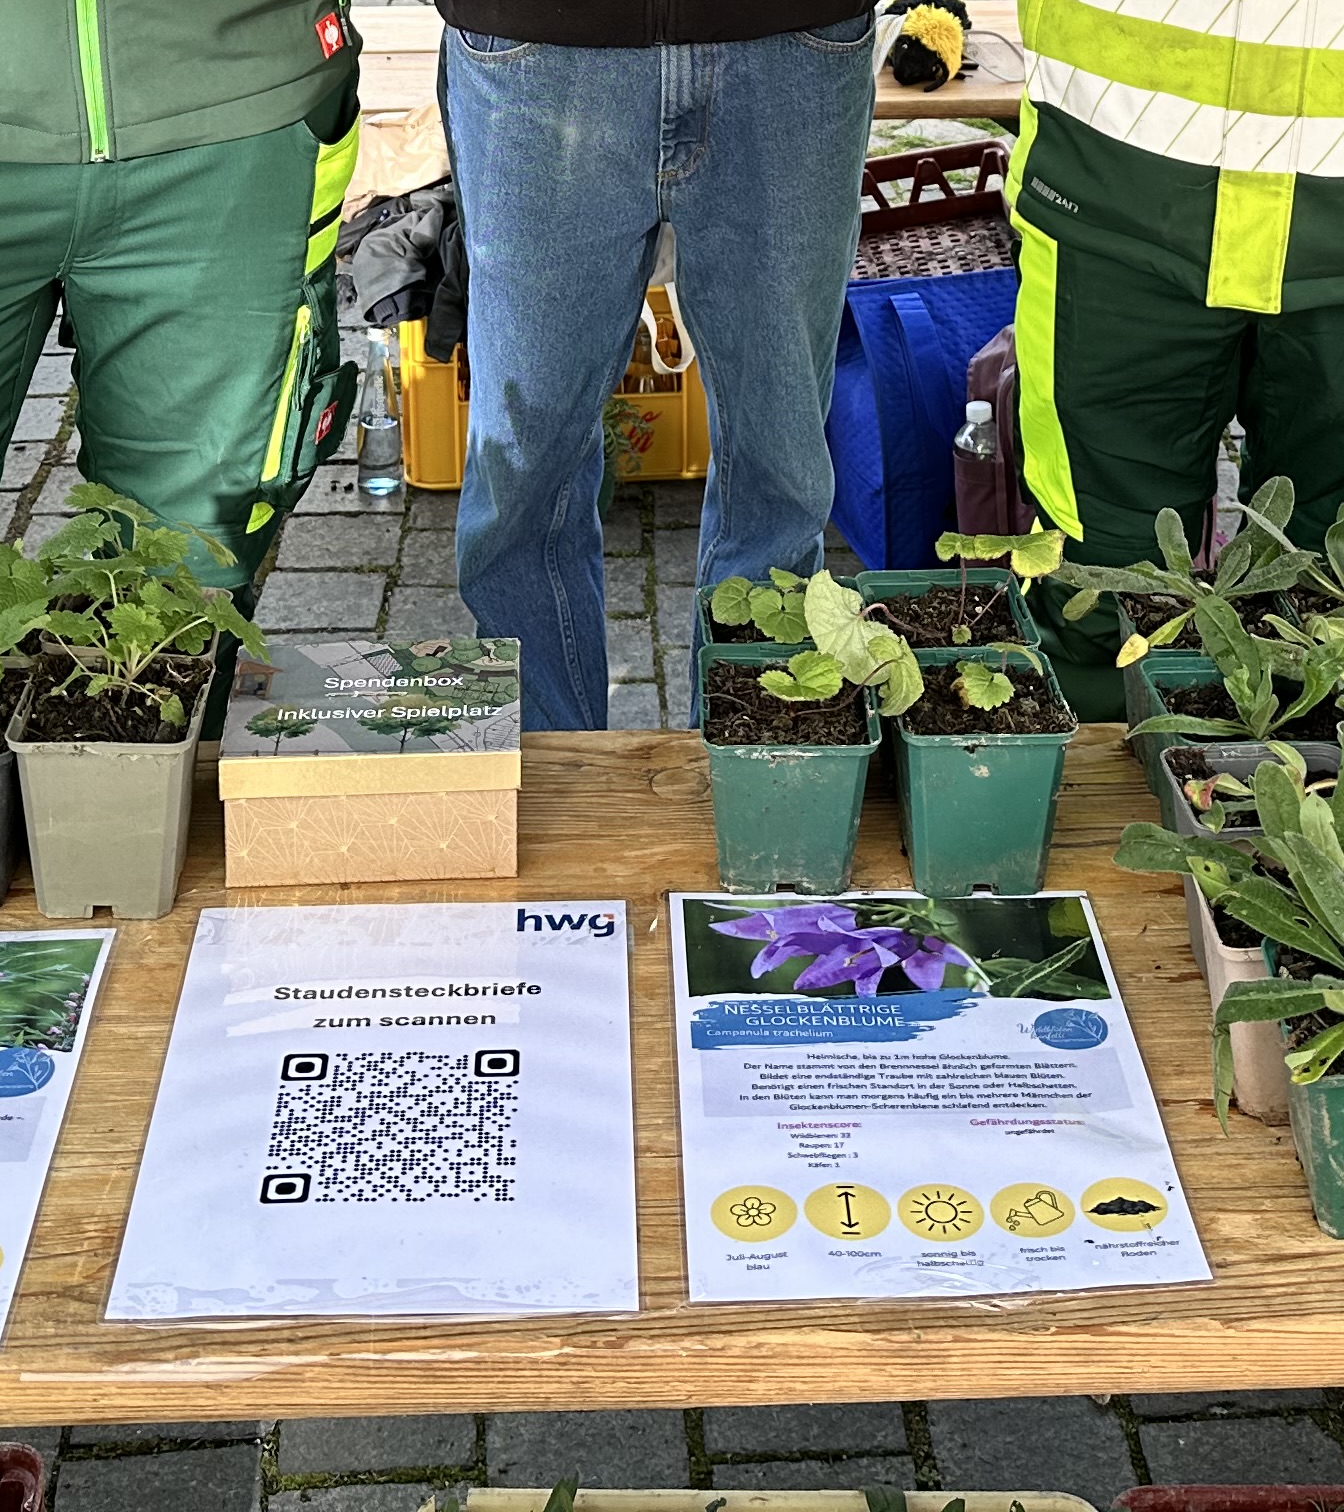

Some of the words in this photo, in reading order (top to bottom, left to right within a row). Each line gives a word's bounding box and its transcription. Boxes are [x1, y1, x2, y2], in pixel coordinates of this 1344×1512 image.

[324, 675, 464, 691] Spendenbox
[277, 706, 387, 721] Inklusiver
[390, 704, 504, 721] Spielplatz
[516, 908, 616, 938] hwg
[273, 982, 543, 1001] Staudensteckbriefe
[724, 1002, 903, 1015] NESSELBLÄTTRIGE
[312, 1016, 372, 1029] zum
[378, 1013, 496, 1027] scannen
[745, 1016, 906, 1027] GLOCKENBLUME
[706, 1028, 770, 1037] Campanula
[772, 1028, 834, 1038] trachelium
[980, 1063, 1032, 1071] geformten
[814, 1072, 876, 1081] endständige
[878, 1072, 914, 1080] Traube
[751, 1082, 795, 1091] Benötigt
[827, 1082, 868, 1090] frischen
[869, 1082, 914, 1090] Standort
[751, 1093, 771, 1101] den
[773, 1093, 807, 1101] Blüten
[860, 1093, 906, 1101] morgens
[906, 1092, 939, 1101] häufig
[941, 1092, 957, 1100] ein
[959, 1092, 974, 1100] bis
[1075, 1091, 1093, 1099] der
[777, 1121, 862, 1130] Insektenscore:
[969, 1118, 1086, 1127] Gefährdungsstatus:
